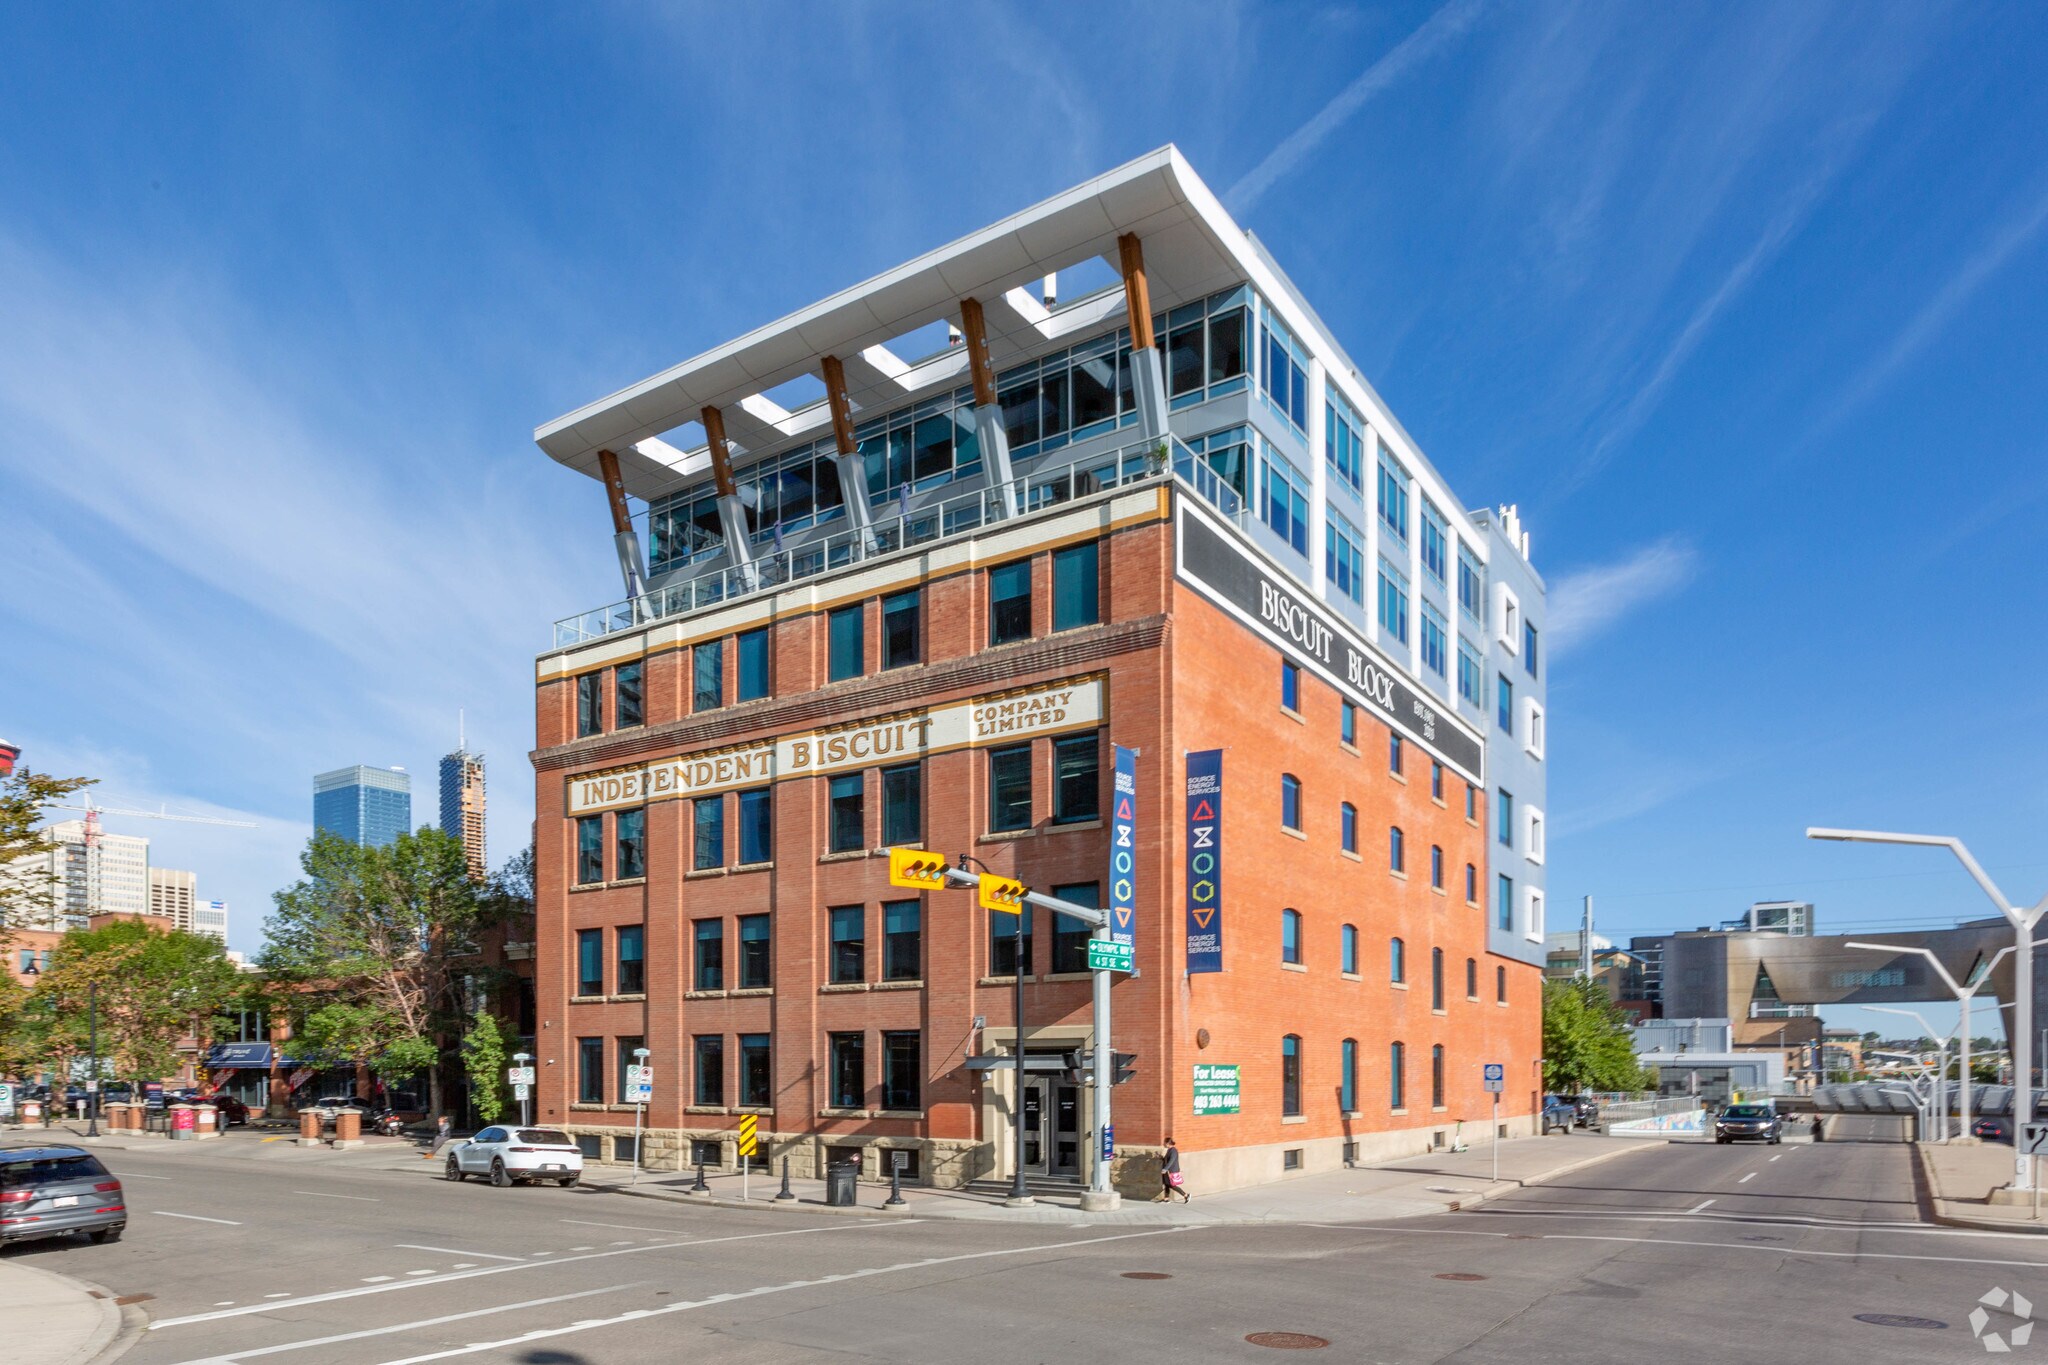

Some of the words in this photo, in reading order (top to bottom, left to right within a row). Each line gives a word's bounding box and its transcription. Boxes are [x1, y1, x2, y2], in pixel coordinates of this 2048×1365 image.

[1260, 579, 1334, 664] BISCUIT
[1347, 648, 1396, 712] BLOCK
[973, 691, 1073, 722] COMPANY
[977, 708, 1066, 736] LIMITED
[583, 750, 776, 806] INDEPENDENT
[791, 718, 934, 769] BISCUIT
[1187, 774, 1216, 784] SOURCE
[1187, 780, 1216, 790] ENERGY
[1187, 786, 1220, 796] SERVICES
[1187, 933, 1216, 942] SOURCE
[1187, 940, 1216, 948] ENERGY
[1187, 945, 1220, 954] SERVICES
[1095, 956, 1100, 966] 4
[1193, 1065, 1210, 1080] For
[1211, 1065, 1236, 1080] Lease
[1194, 1095, 1208, 1108] 403
